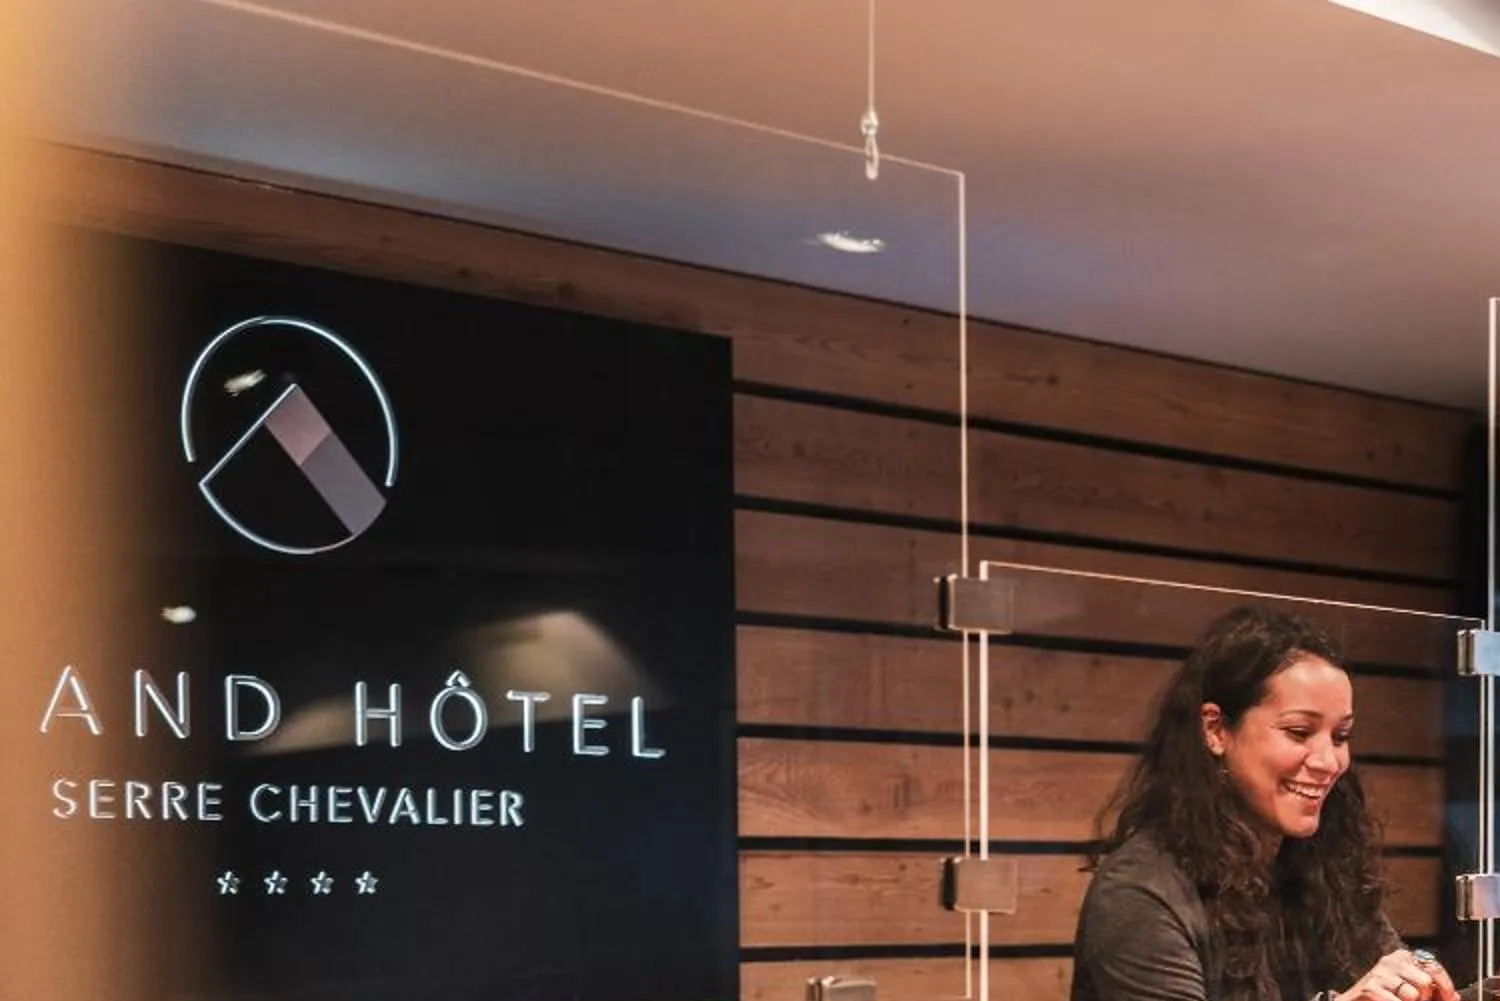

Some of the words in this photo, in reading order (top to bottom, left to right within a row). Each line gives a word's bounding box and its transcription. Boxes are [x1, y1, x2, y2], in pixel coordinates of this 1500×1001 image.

[354, 670, 667, 759] HÔTEL
[51, 778, 224, 822] SERRE
[249, 782, 526, 827] CHEVALIER
